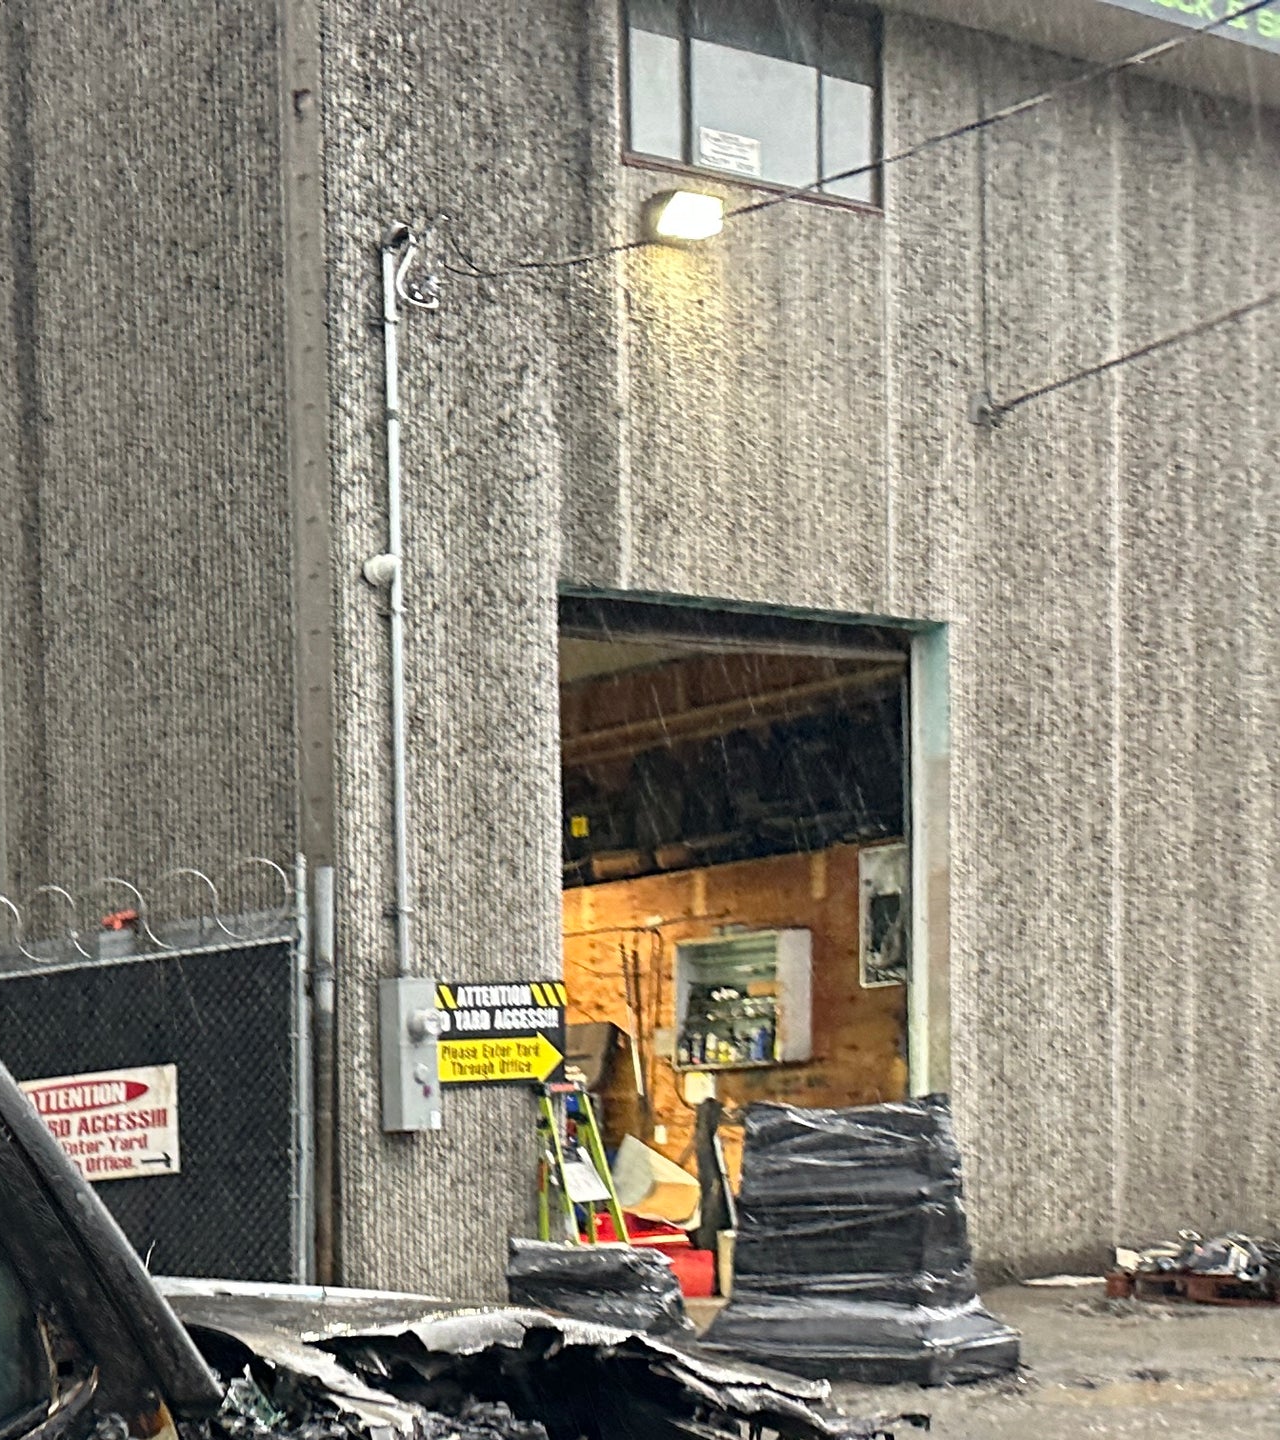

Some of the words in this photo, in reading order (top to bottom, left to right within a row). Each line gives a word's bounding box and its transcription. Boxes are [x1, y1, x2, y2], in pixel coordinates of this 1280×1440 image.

[457, 984, 532, 1007] ATTENTION
[441, 1044, 477, 1061] Please
[482, 1042, 513, 1059] Enter
[516, 1042, 540, 1057] Yard
[451, 1060, 494, 1076] Through
[499, 1058, 533, 1074] Office
[108, 1133, 148, 1152] Yard
